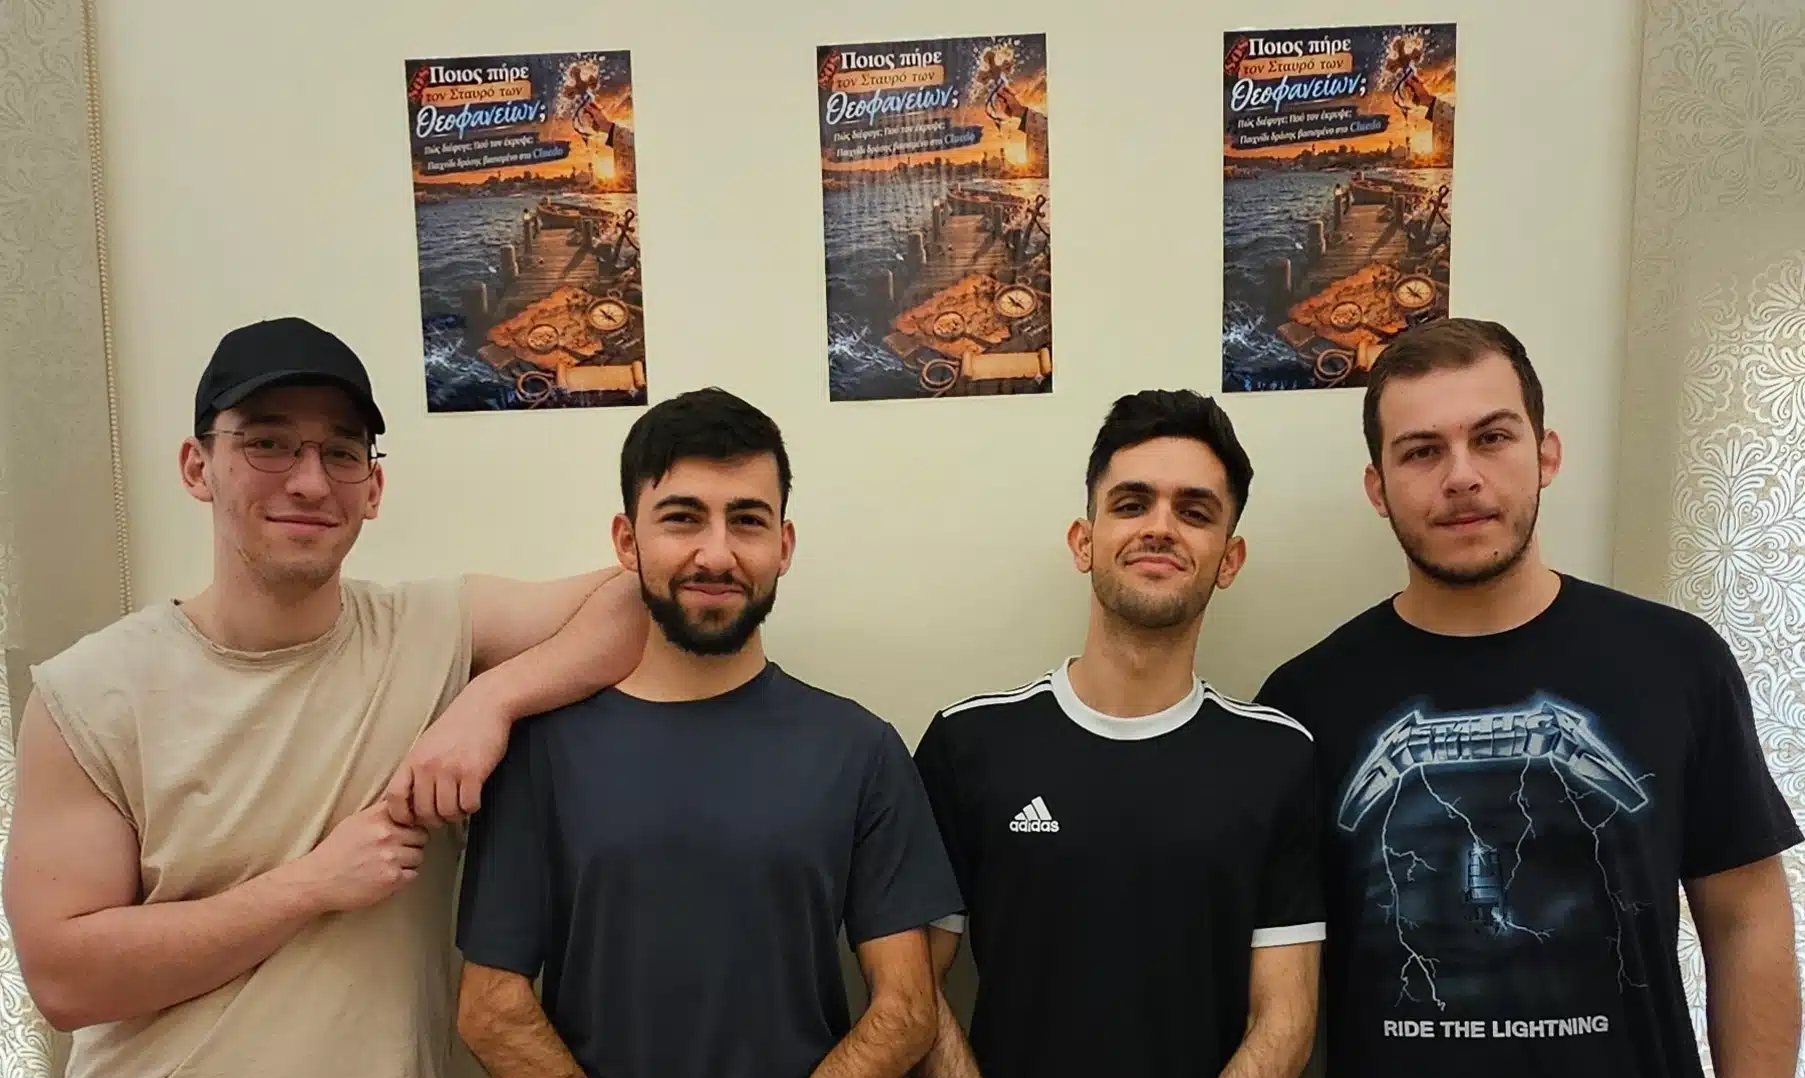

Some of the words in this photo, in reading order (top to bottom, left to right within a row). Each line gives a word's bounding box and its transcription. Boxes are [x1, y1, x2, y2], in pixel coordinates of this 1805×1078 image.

[1249, 38, 1303, 56] Ποιος
[1308, 35, 1351, 54] πήρε
[841, 51, 895, 70] Ποιος
[900, 48, 942, 68] πήρε
[1243, 64, 1264, 75] τον
[1268, 59, 1315, 74] Σταυρό
[1320, 58, 1344, 70] των
[430, 66, 483, 85] Ποιος
[486, 63, 529, 83] πήρε
[837, 77, 857, 88] τον
[861, 72, 907, 86] Σταυρό
[912, 71, 935, 82] των
[426, 91, 446, 102] τον
[450, 86, 495, 101] Σταυρό
[500, 87, 523, 97] των
[1230, 73, 1367, 113] Θεοφανείων;
[826, 86, 959, 126] Θεοφανείων;
[416, 101, 546, 139] Θεοφανείων;
[1307, 113, 1319, 121] τον
[1009, 819, 1060, 832] adidas
[1383, 1019, 1435, 1038] RIDE
[1440, 1021, 1486, 1038] THE
[1492, 1015, 1609, 1038] LIGHTNING
